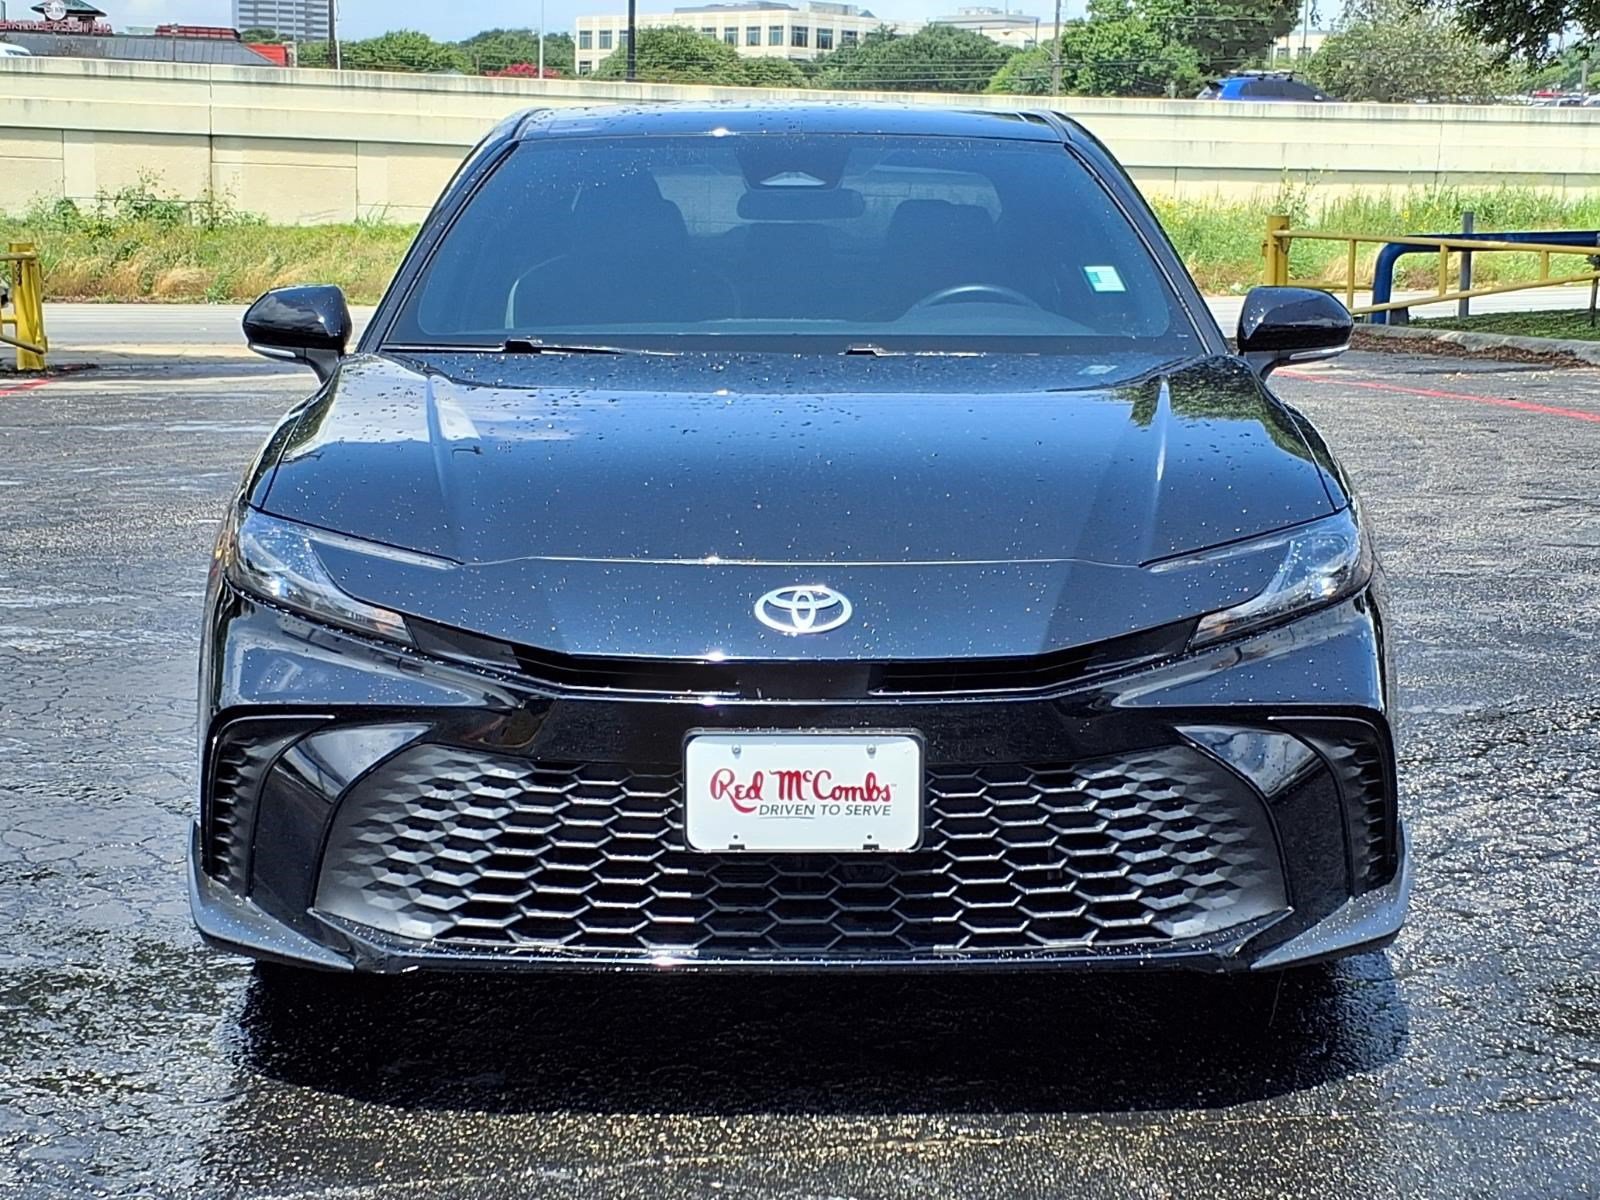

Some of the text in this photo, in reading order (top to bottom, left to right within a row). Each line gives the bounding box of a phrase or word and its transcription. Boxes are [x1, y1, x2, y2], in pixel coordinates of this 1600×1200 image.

[710, 768, 763, 813] Red
[758, 804, 892, 816] DRIVEN TO SERVE
